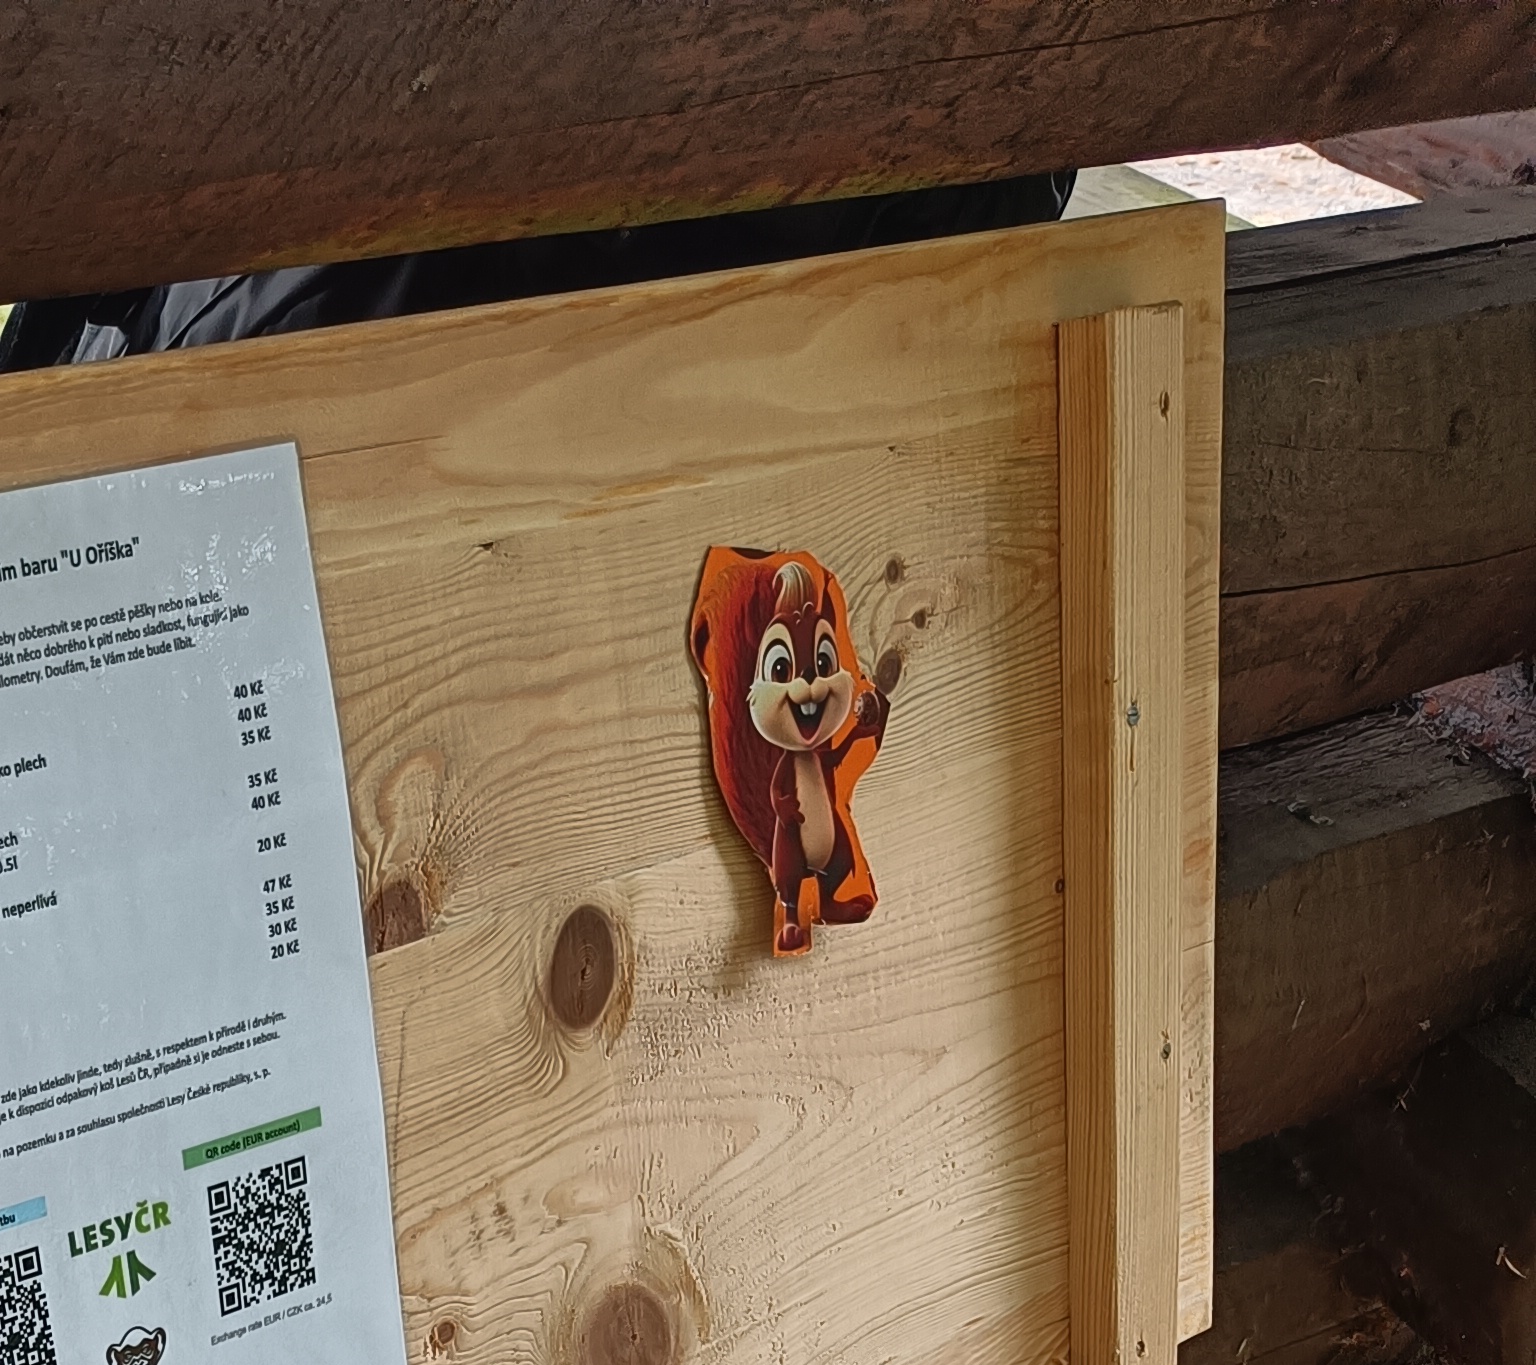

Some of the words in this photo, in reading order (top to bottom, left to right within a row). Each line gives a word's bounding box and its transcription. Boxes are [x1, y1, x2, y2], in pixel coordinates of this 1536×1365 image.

[19, 557, 58, 577] baru
[59, 548, 82, 568] "U
[85, 536, 140, 565] Oříška"
[17, 619, 70, 642] občerstvit
[70, 619, 83, 632] se
[83, 616, 98, 632] po
[99, 607, 127, 626] cestě
[127, 602, 156, 623] pěšky
[157, 597, 184, 614] nebo
[184, 596, 198, 608] na
[16, 647, 42, 664] něco
[43, 638, 87, 658] dobrého
[96, 630, 114, 650] pití
[114, 627, 141, 643] nebo
[142, 618, 186, 638] sladkost,
[228, 604, 250, 623] jako
[44, 659, 89, 679] Doufám,
[89, 655, 102, 669] že
[101, 650, 126, 666] Vám
[126, 646, 146, 661] zde
[145, 640, 173, 657] bude
[233, 684, 249, 700] 40
[249, 679, 264, 697] Kč
[237, 707, 252, 723] 40
[253, 702, 268, 720] Kč
[240, 729, 256, 747] 35
[256, 725, 272, 743] Kč
[13, 753, 47, 778] plech
[247, 772, 262, 789] 35
[263, 767, 279, 785] Kč
[251, 795, 266, 811] 40
[266, 790, 282, 807] Kč
[256, 837, 272, 853] 20
[272, 832, 287, 849] Kč
[262, 878, 276, 894] 47
[278, 873, 293, 891] Kč
[1, 890, 58, 919] neperlivá
[265, 900, 280, 917] 35
[281, 895, 295, 912] Kč
[268, 922, 283, 938] 30
[283, 917, 298, 934] Kč
[270, 943, 285, 960] 20
[286, 938, 300, 956] Kč
[205, 1146, 220, 1159] QR
[220, 1139, 241, 1155] code
[242, 1131, 264, 1150] (EUR
[264, 1118, 301, 1141] account)
